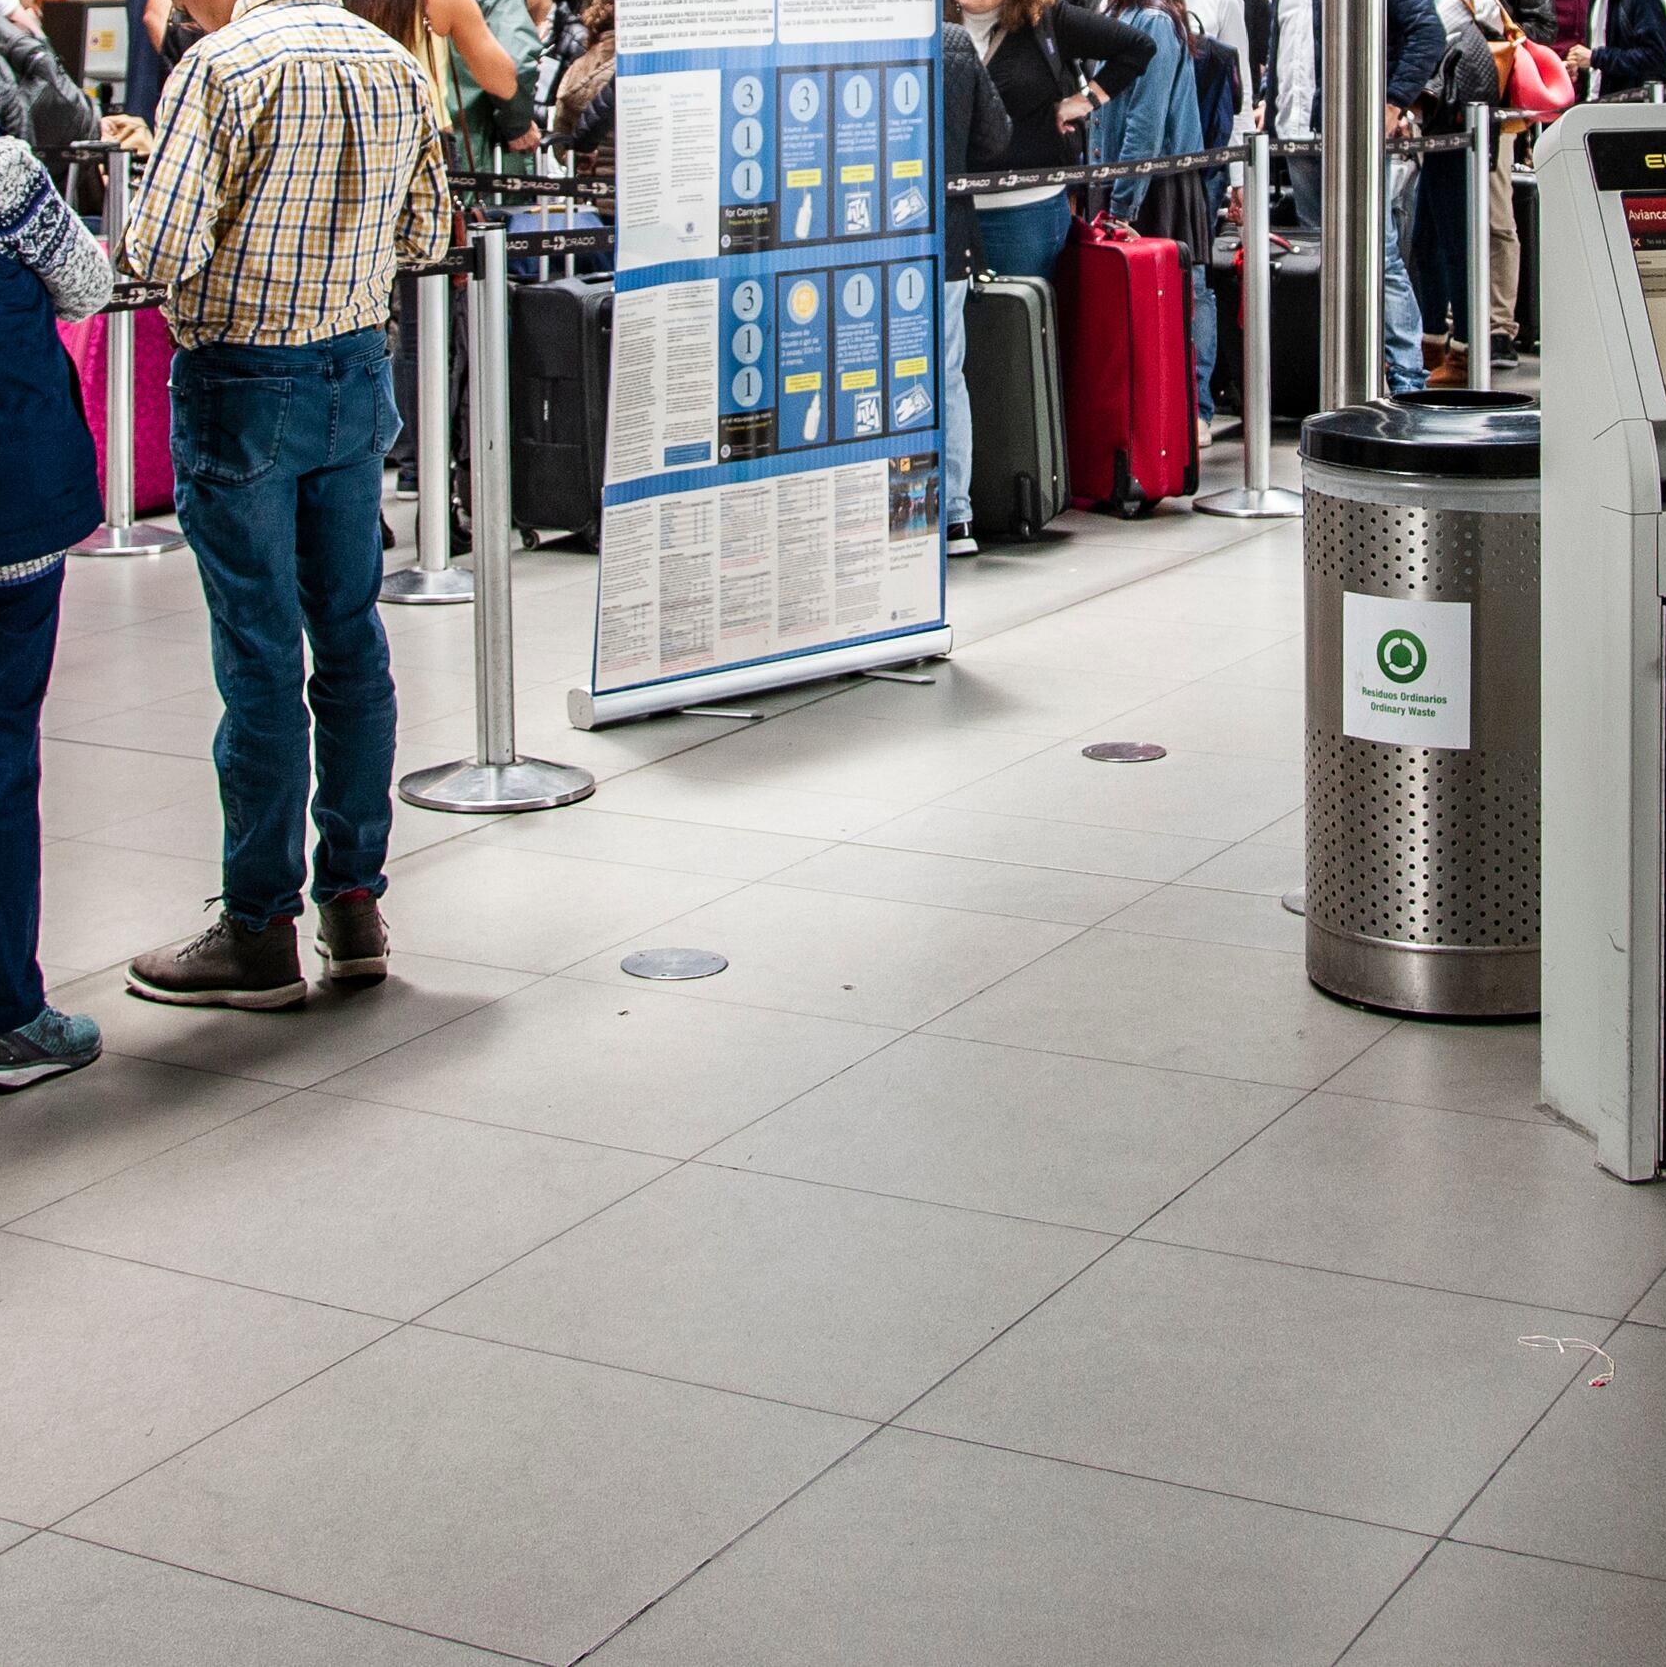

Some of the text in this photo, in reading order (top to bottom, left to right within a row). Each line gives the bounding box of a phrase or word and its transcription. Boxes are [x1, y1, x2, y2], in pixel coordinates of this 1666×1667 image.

[741, 83, 754, 109] 3
[799, 85, 811, 113] 3
[855, 83, 861, 110] 1
[904, 80, 910, 106] 1
[745, 125, 751, 150] 1
[745, 167, 752, 191] 1
[725, 208, 735, 217] for
[743, 286, 754, 312] 3
[856, 279, 862, 306] 1
[908, 273, 913, 299] 1
[745, 329, 752, 354] 1
[745, 372, 752, 398] 1
[1362, 686, 1448, 704] Residuos Ordinarios
[1370, 701, 1436, 718] Ordinary Waste
